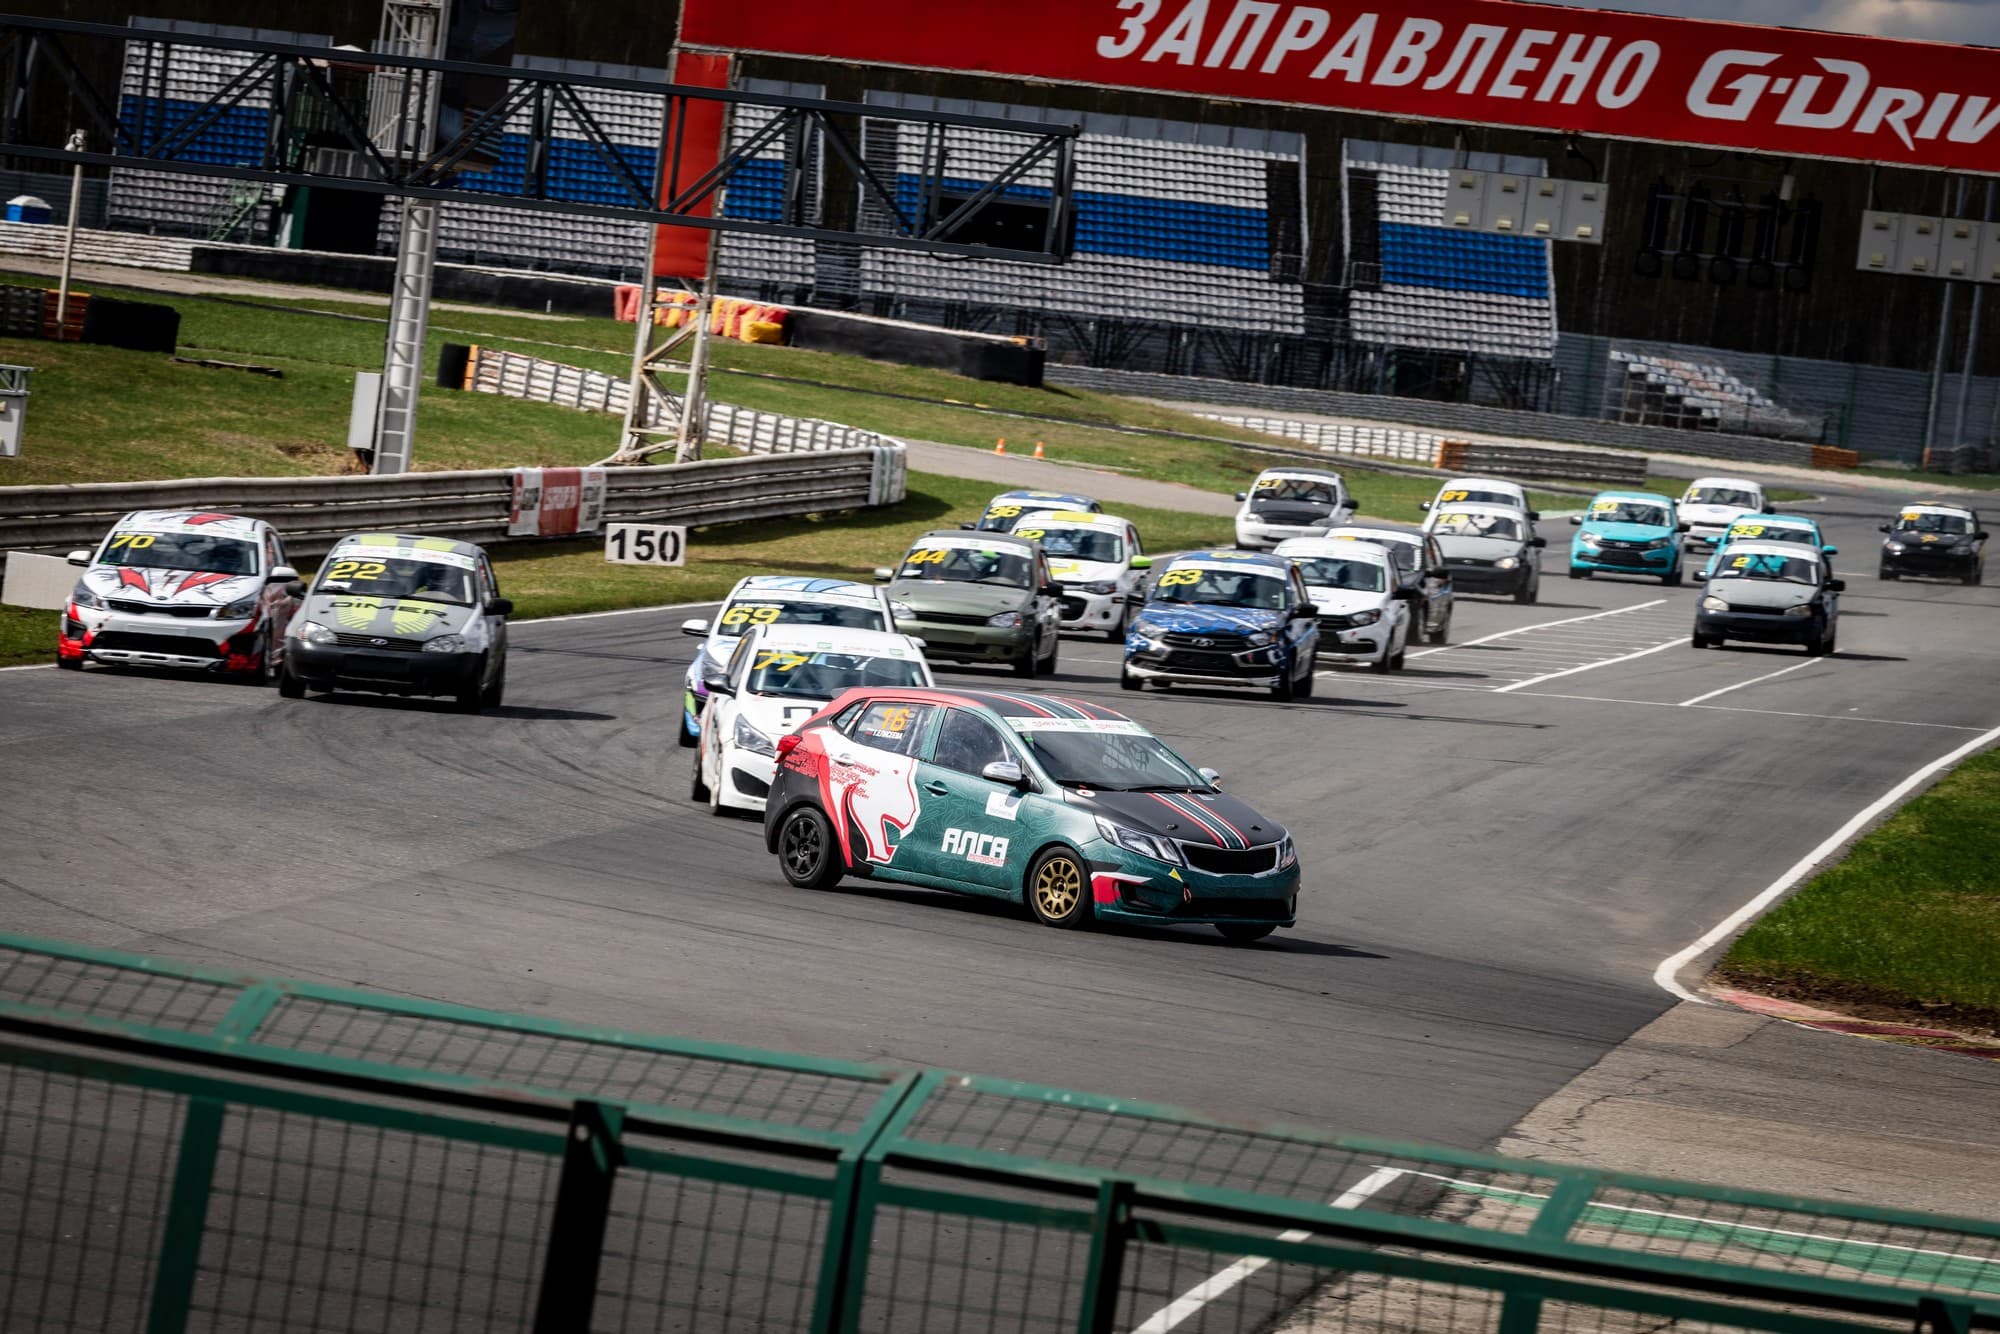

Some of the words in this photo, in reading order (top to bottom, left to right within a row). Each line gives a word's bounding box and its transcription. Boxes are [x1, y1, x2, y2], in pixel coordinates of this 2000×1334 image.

[1096, 0, 1661, 109] ЗАПРАВЛЕНО
[109, 534, 156, 549] 70
[611, 529, 680, 562] 150
[906, 550, 947, 564] 44
[1732, 556, 1752, 568] 2
[326, 561, 387, 580] 22
[1159, 569, 1203, 587] 63
[329, 601, 447, 617] DIMER
[721, 607, 782, 625] 69
[753, 651, 809, 671] 77
[881, 707, 910, 732] 16
